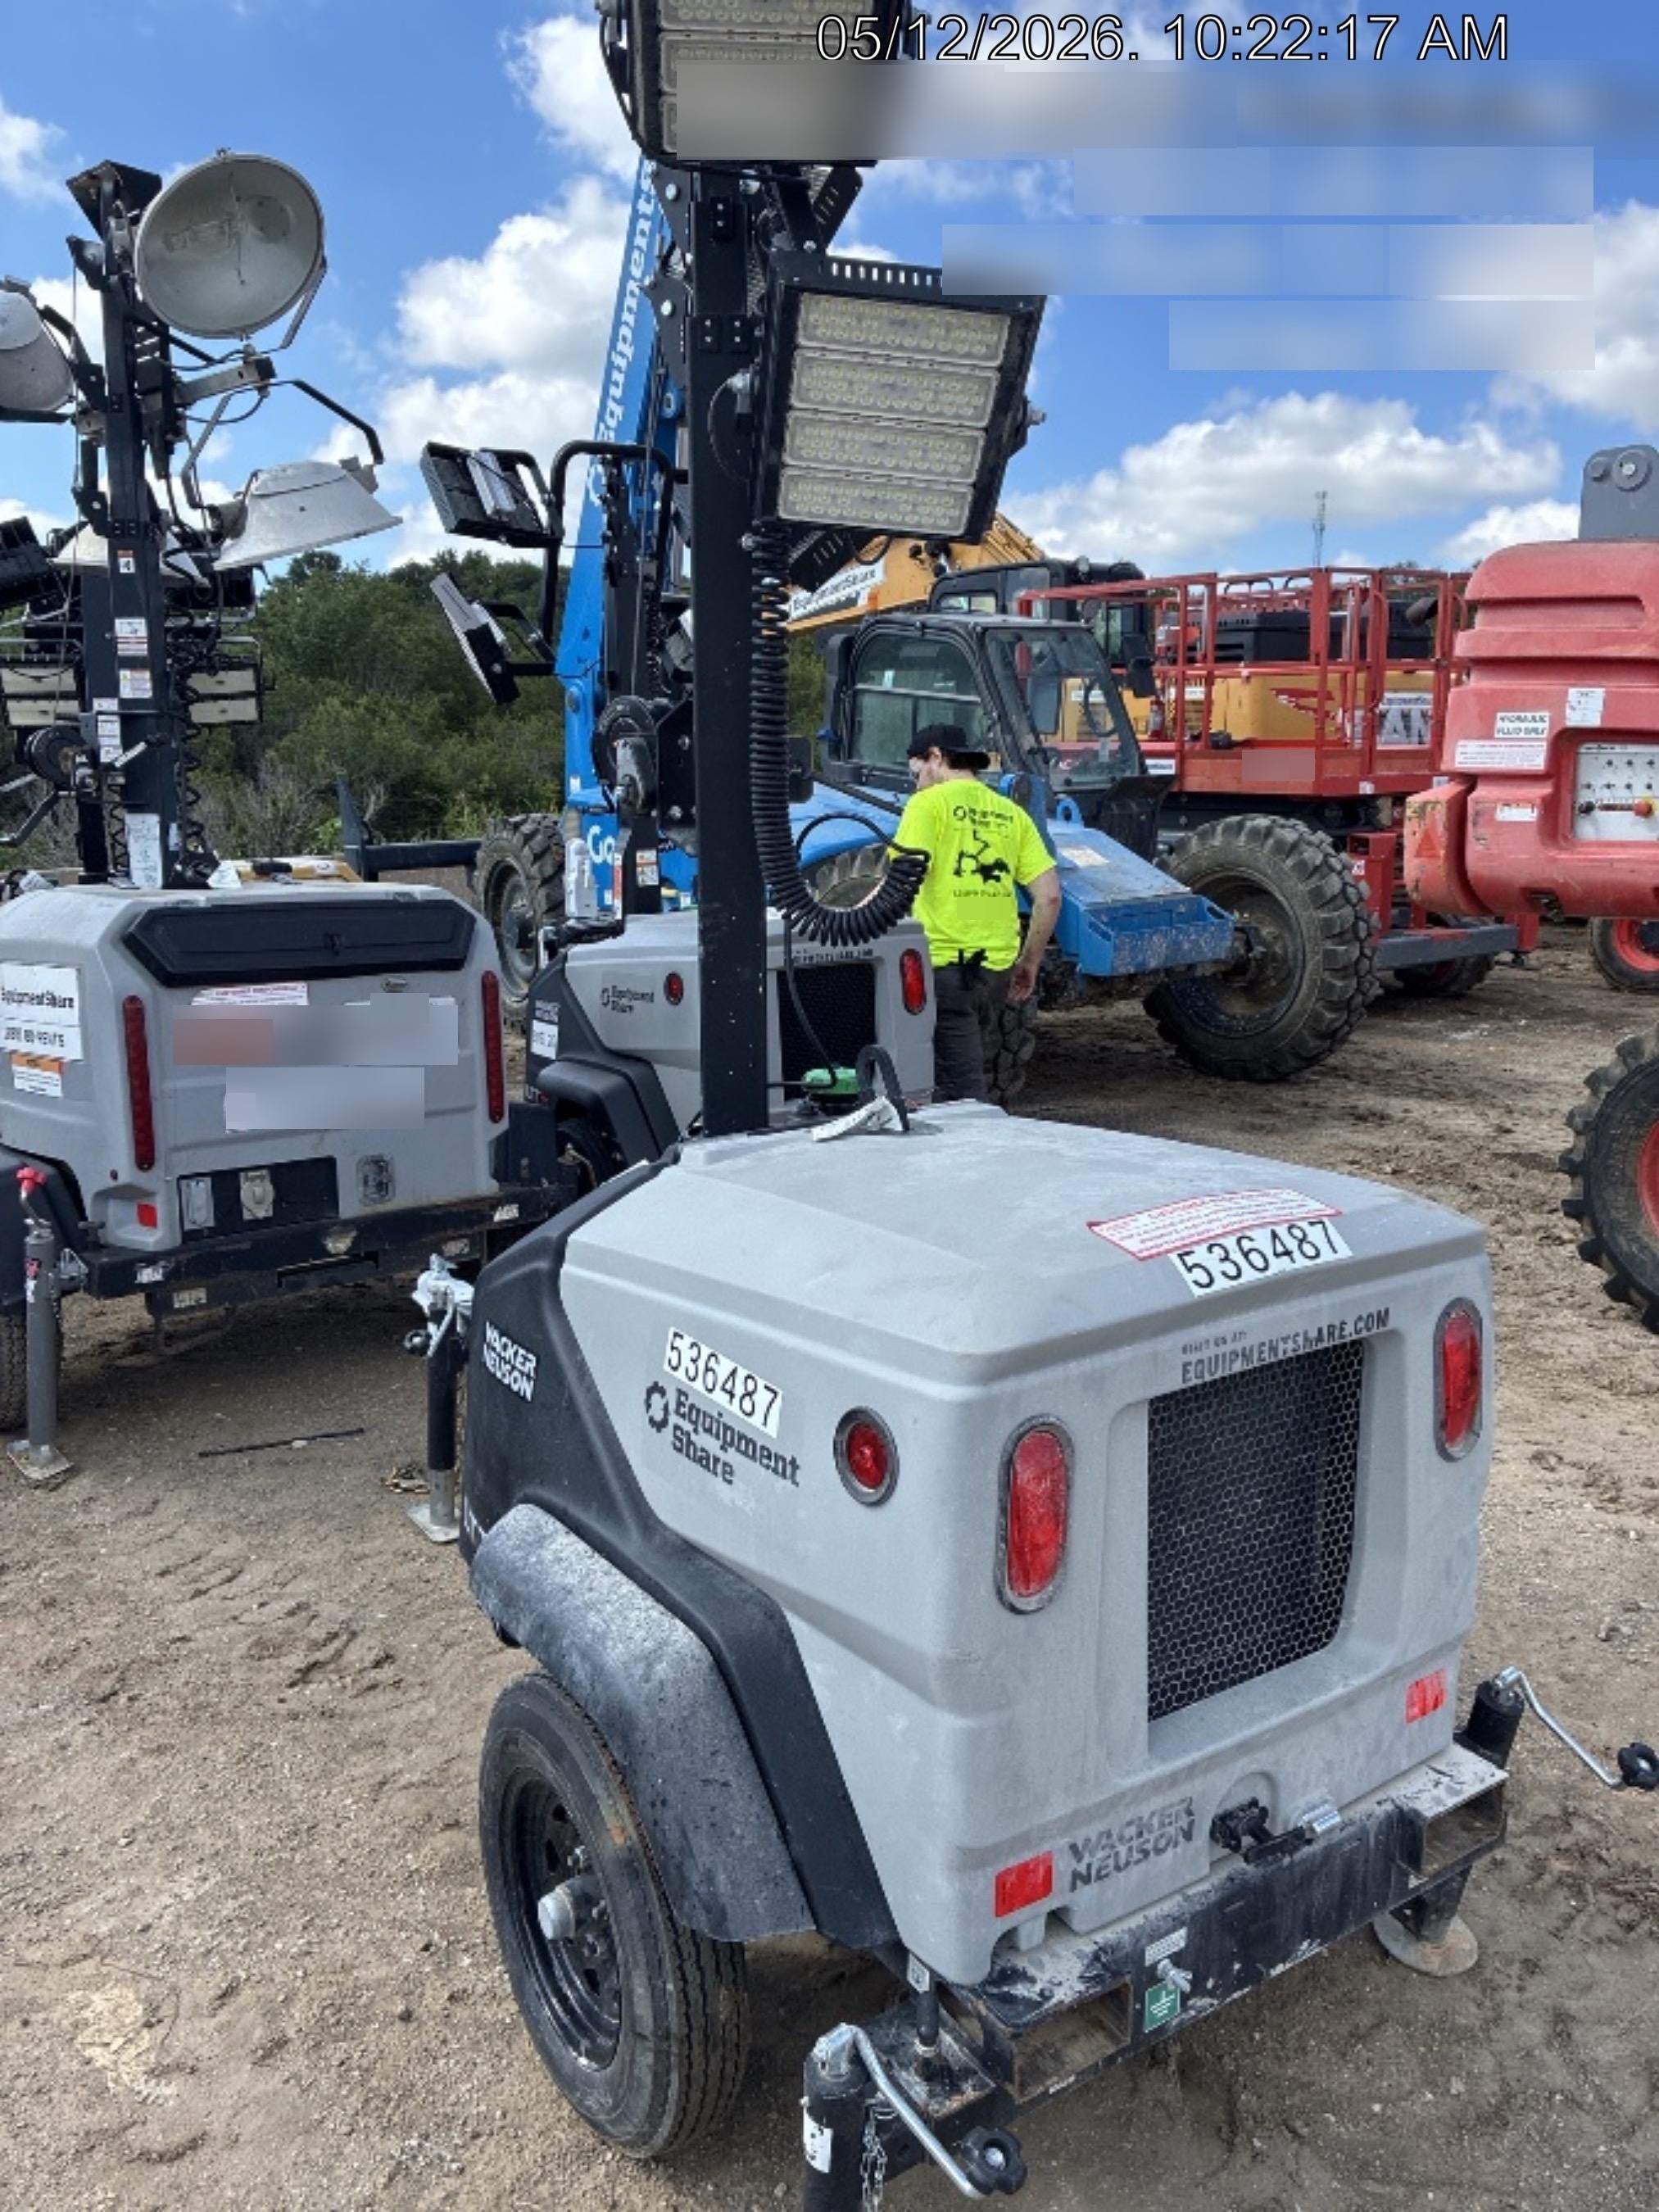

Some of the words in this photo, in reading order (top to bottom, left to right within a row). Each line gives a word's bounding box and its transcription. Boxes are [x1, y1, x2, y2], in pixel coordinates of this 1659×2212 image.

[1177, 1219, 1339, 1289] 536487
[483, 1342, 534, 1402] NEUSON
[485, 1320, 537, 1377] WACKER
[668, 1330, 780, 1428] 536487
[1181, 1307, 1390, 1385] EQUIPMENTSHARE.COM
[671, 1422, 736, 1485] Share
[674, 1386, 800, 1489] Equipment
[1069, 1795, 1195, 1864] WACKER
[1069, 1818, 1195, 1893] NEUSON
